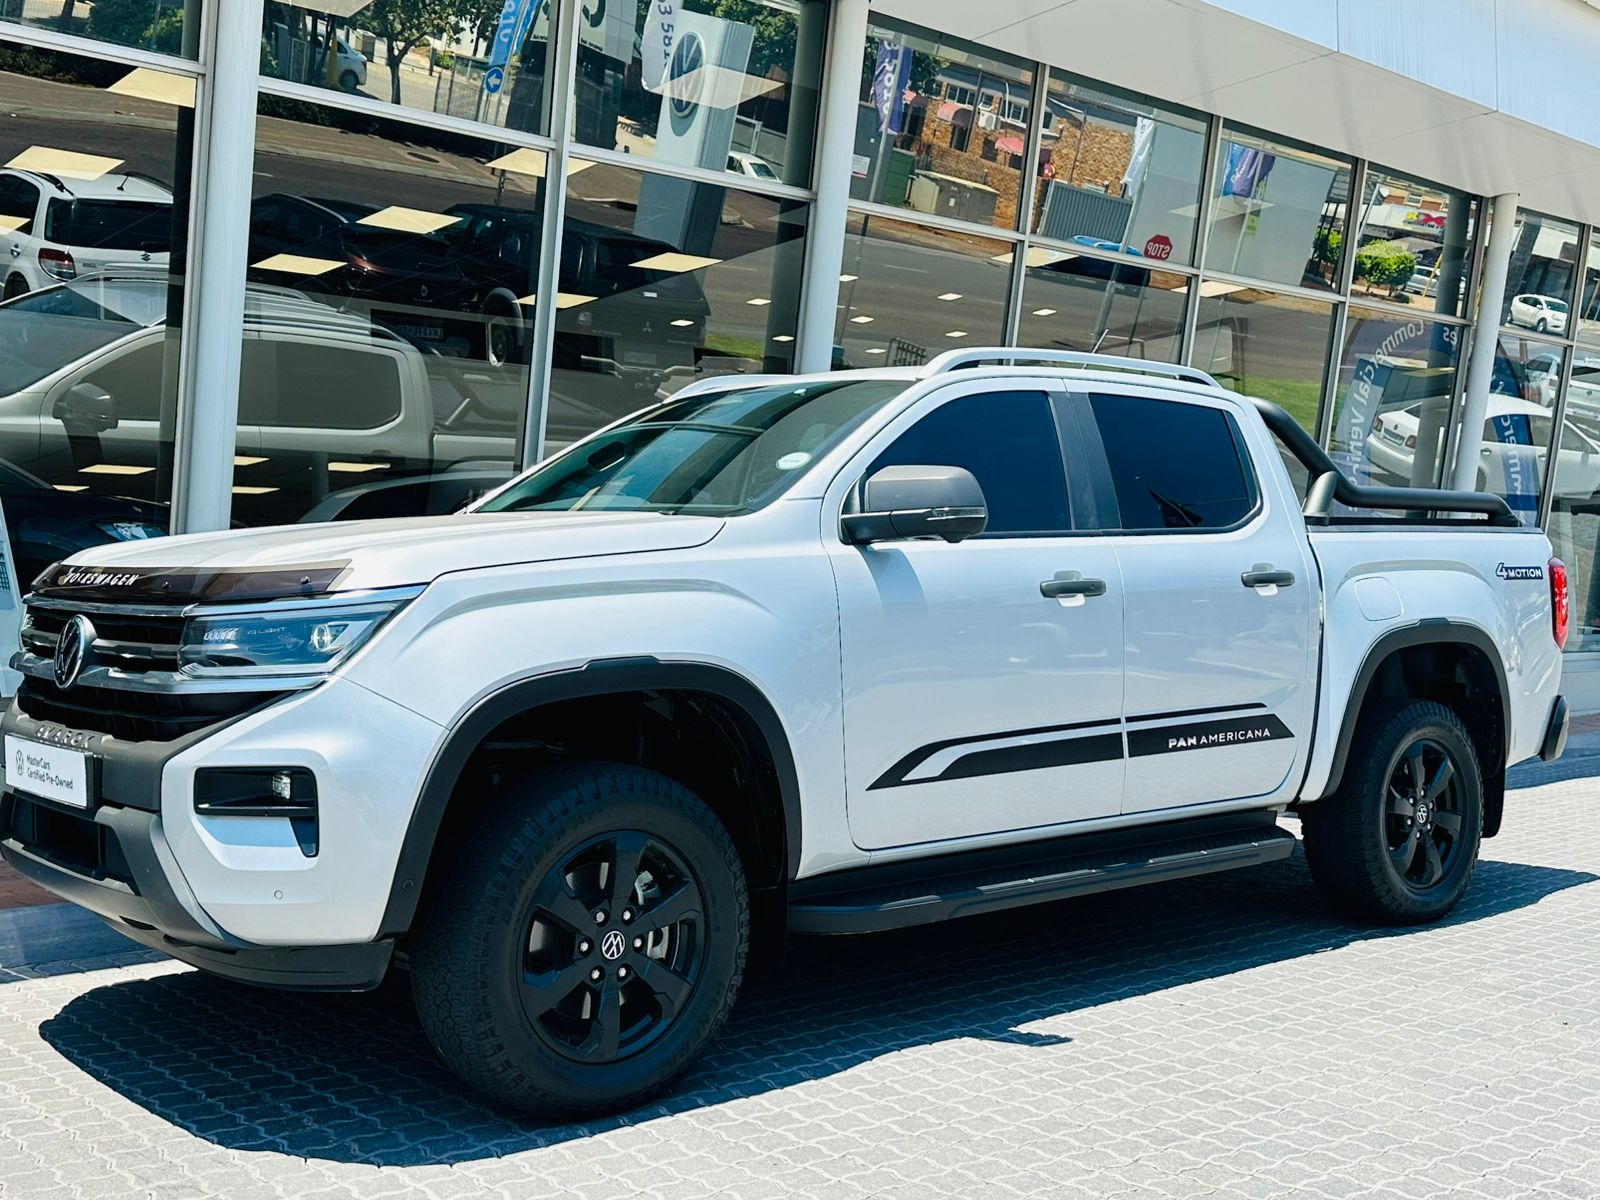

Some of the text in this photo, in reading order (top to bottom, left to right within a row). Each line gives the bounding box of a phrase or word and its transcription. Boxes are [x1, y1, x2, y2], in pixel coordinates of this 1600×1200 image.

[64, 572, 139, 586] VOLKSWAGEN
[1495, 562, 1543, 580] 4MOTION
[1168, 728, 1271, 749] PAN AMERICANA
[27, 754, 51, 770] MasterCars
[27, 767, 74, 789] Certified Pre-Owned
